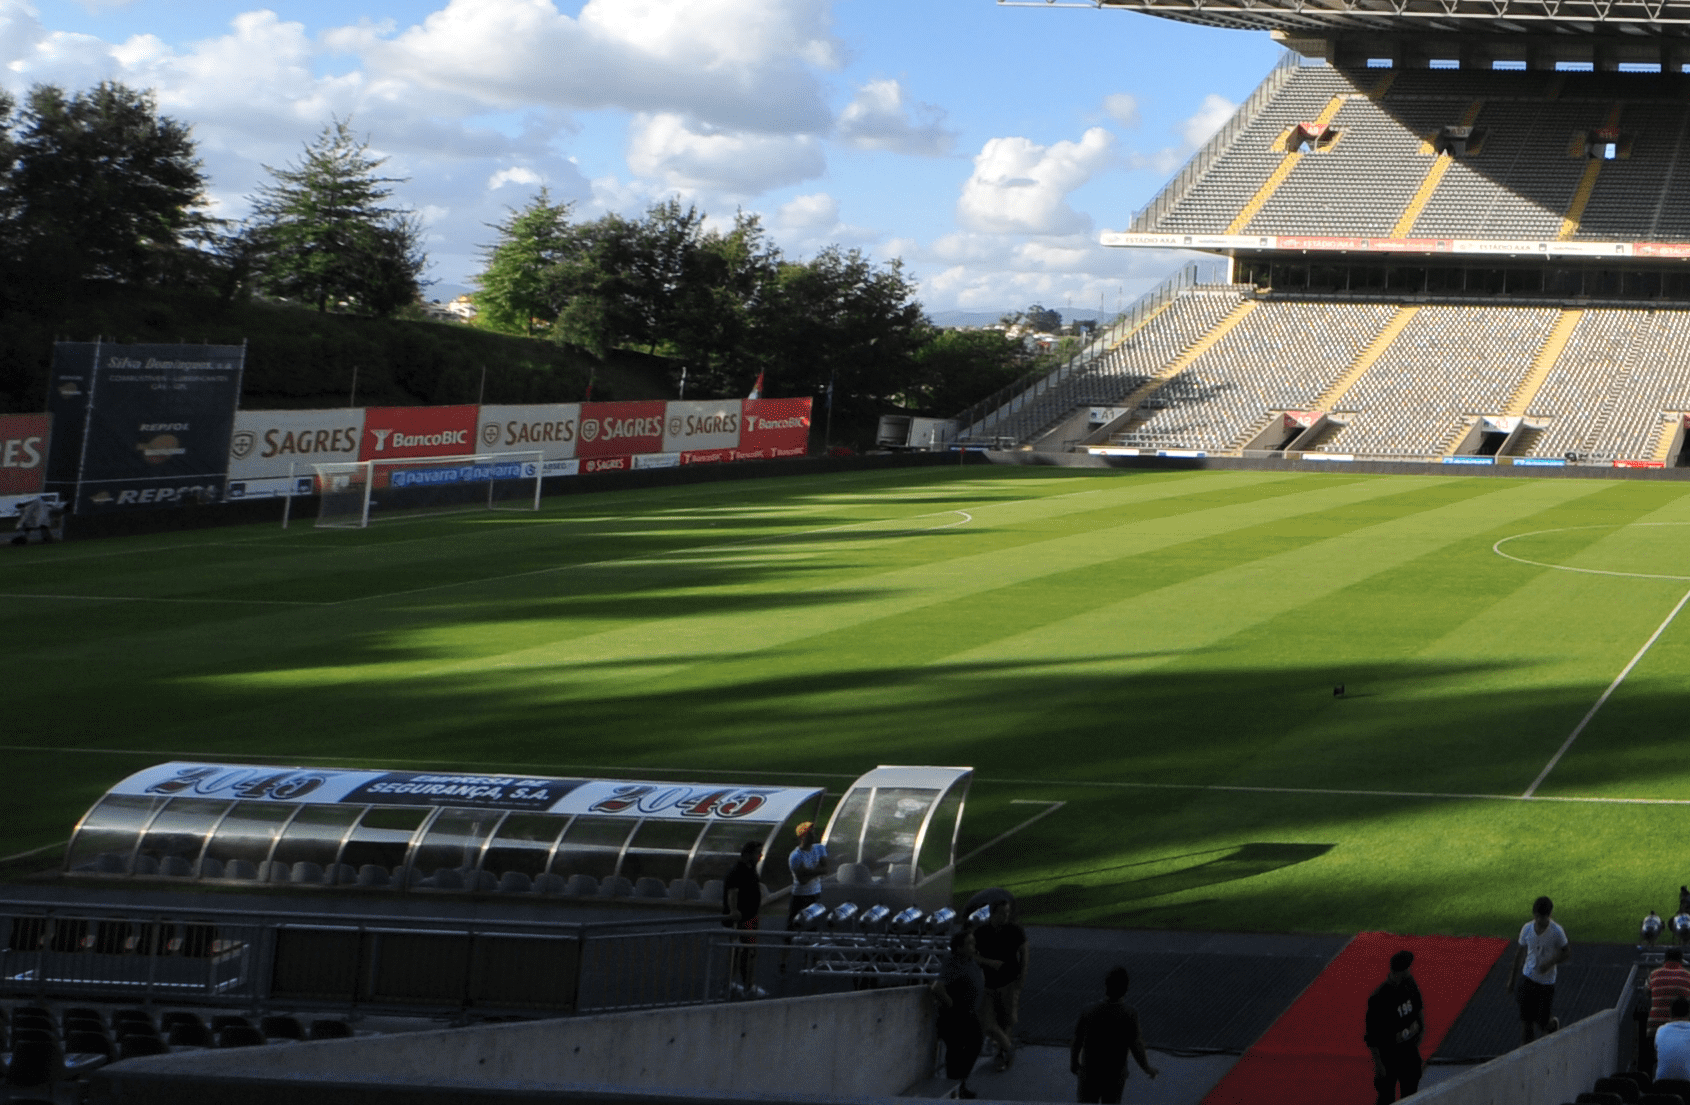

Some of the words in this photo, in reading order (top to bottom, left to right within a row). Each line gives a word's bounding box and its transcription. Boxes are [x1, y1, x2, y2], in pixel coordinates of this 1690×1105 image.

[139, 422, 191, 432] REPSOL
[505, 420, 574, 445] SAGRES
[601, 415, 662, 441] SAGRES
[685, 414, 738, 437] SAGRES
[261, 426, 357, 458] SAGRES
[392, 429, 468, 448] BancoBIC
[145, 765, 342, 800] 2045
[366, 781, 504, 800] SEGURANÇA,
[509, 787, 550, 801] S.A.
[409, 774, 514, 787] EMPRESA
[514, 779, 550, 788] DE
[588, 785, 785, 818] 2045
